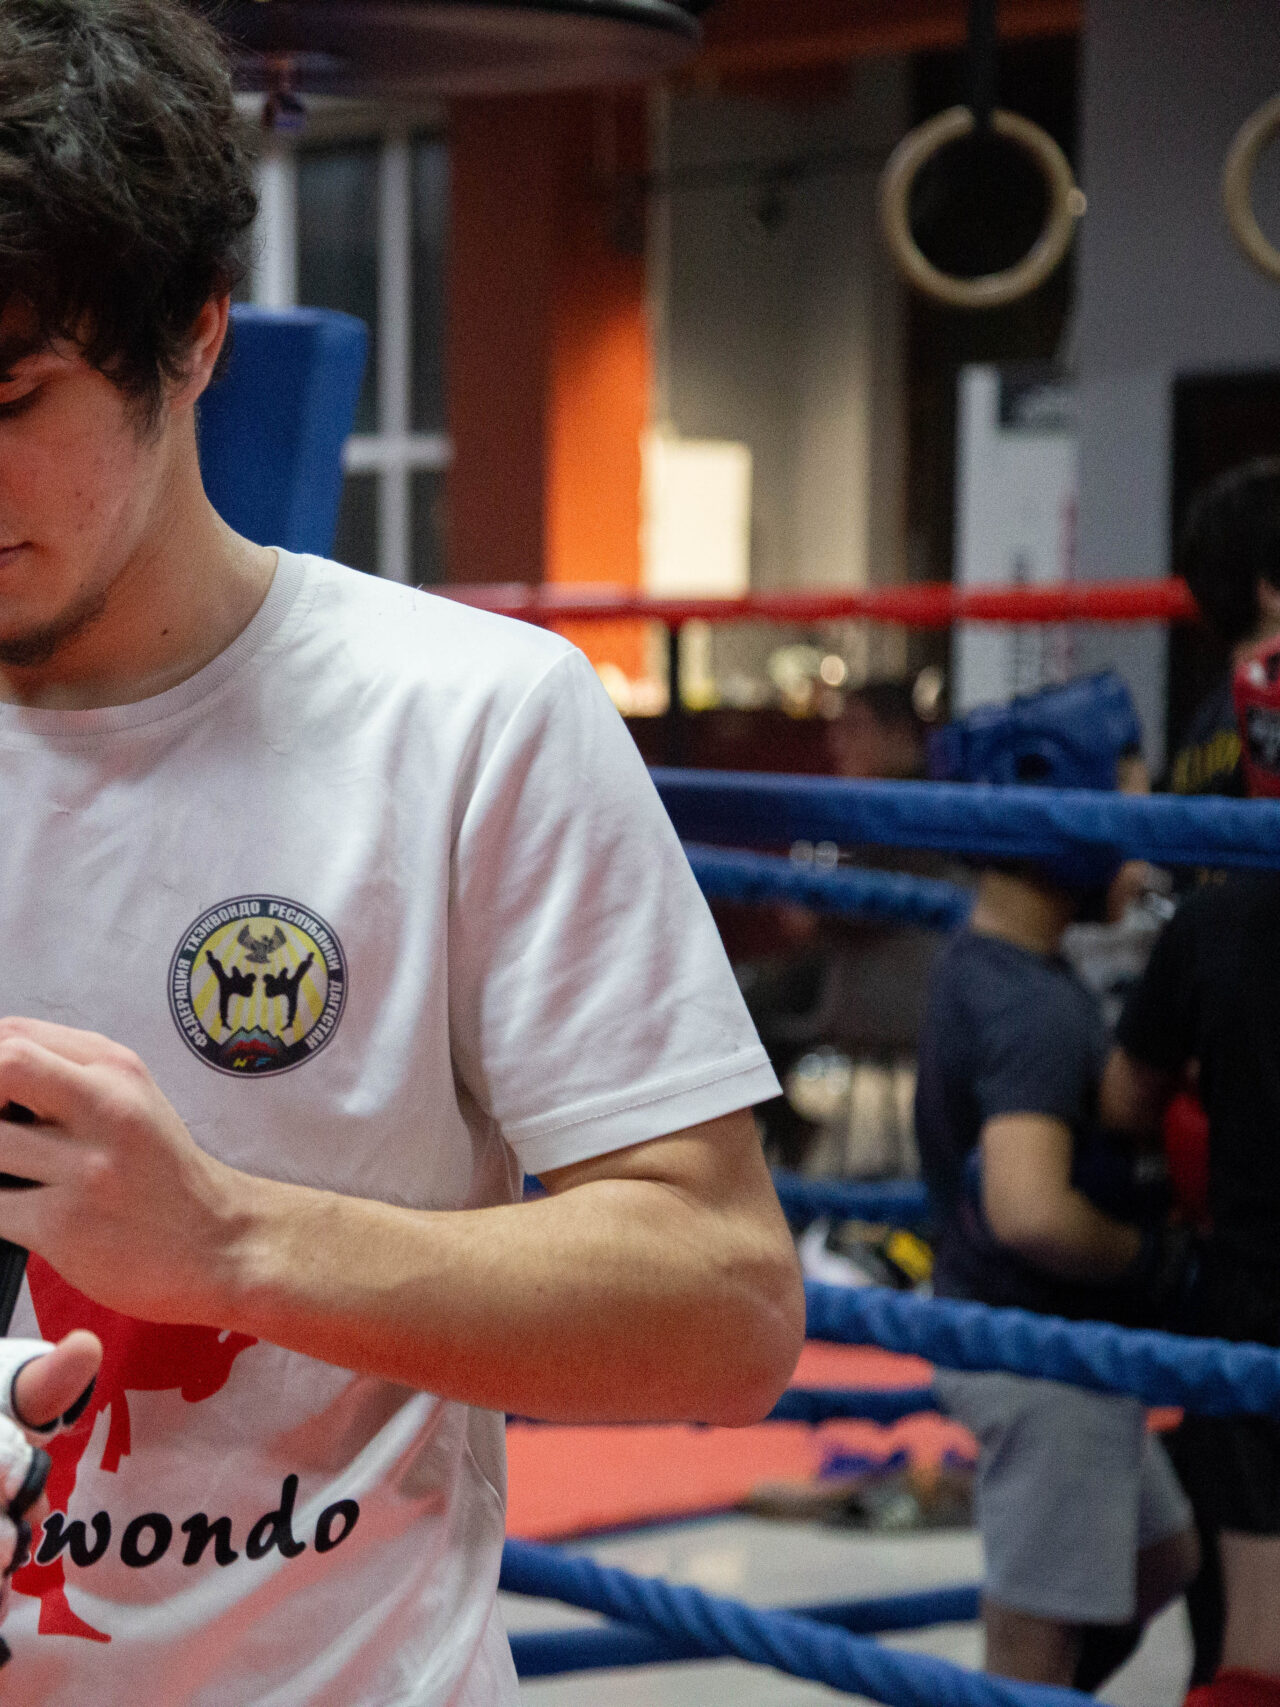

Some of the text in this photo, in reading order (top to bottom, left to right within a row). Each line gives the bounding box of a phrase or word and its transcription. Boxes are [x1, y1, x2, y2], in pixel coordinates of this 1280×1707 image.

[173, 901, 343, 1050] ФЕДЕРАЦИЯ ТХЭКВОНДО РЕСПУБЛИКИ ДАГЕСТАН
[23, 1473, 360, 1568] wondo
